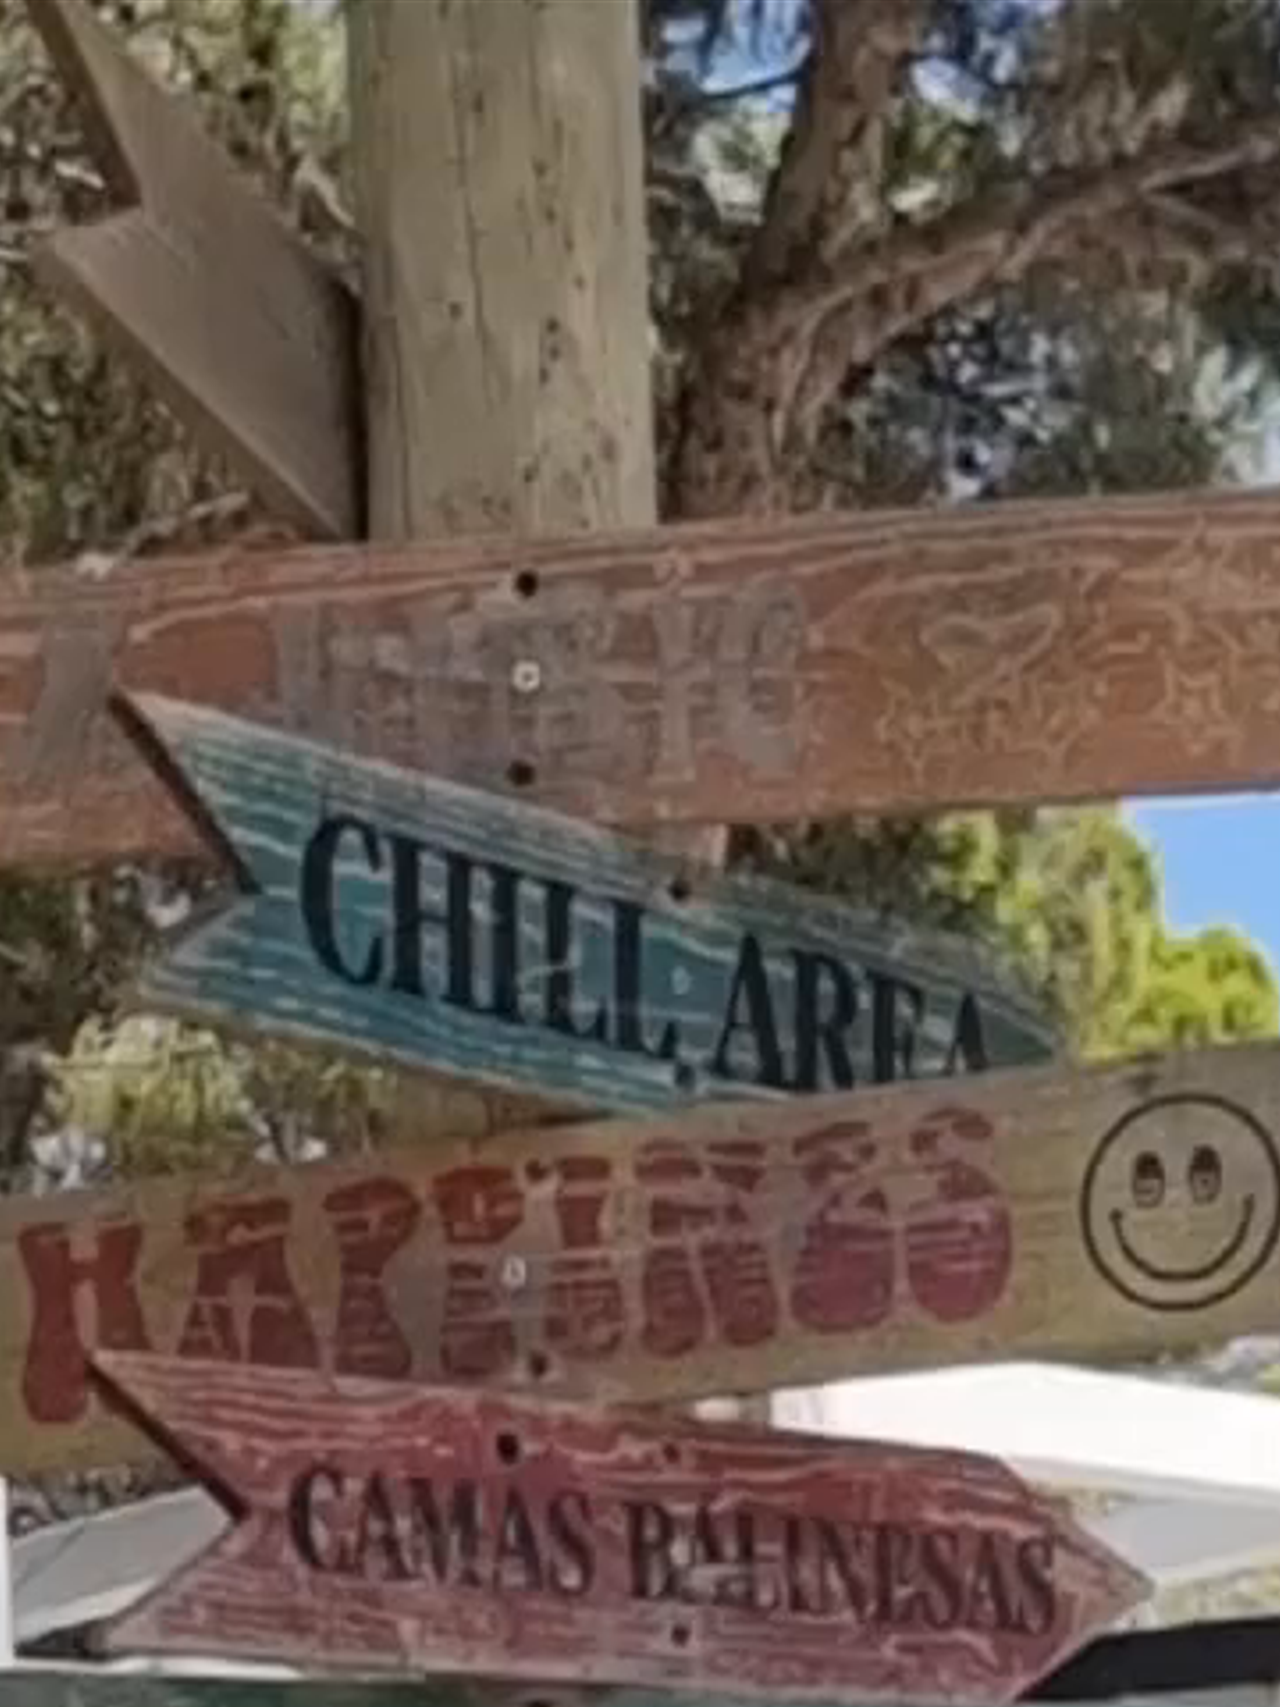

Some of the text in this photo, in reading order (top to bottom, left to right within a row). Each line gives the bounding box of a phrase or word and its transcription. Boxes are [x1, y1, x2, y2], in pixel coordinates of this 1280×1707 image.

[301, 814, 680, 1059] CHILL
[288, 1462, 1056, 1638] CAMAS BALINESAS
